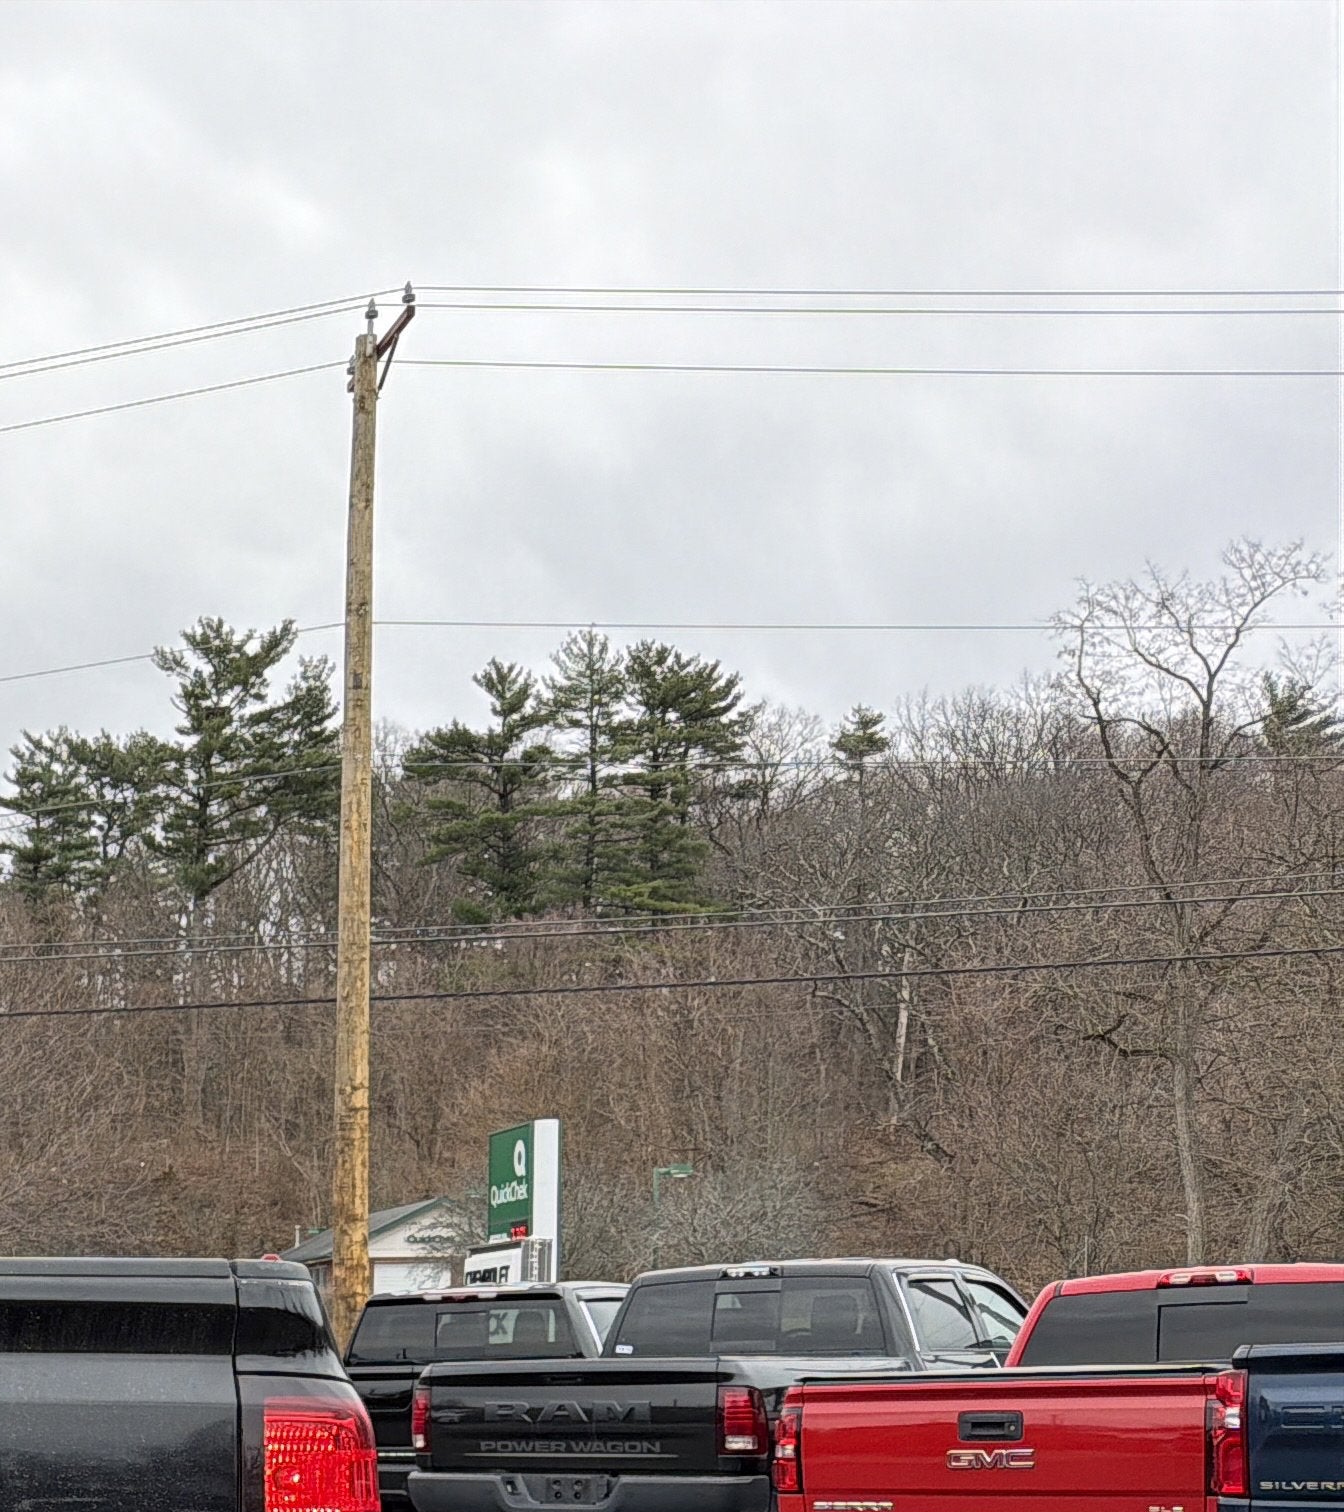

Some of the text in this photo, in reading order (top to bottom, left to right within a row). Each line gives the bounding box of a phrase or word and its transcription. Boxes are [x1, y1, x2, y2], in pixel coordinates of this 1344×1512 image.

[490, 1179, 529, 1208] QuickChek
[483, 1400, 652, 1424] RAM
[480, 1441, 661, 1453] POWER WAGON
[946, 1448, 1035, 1469] GMC
